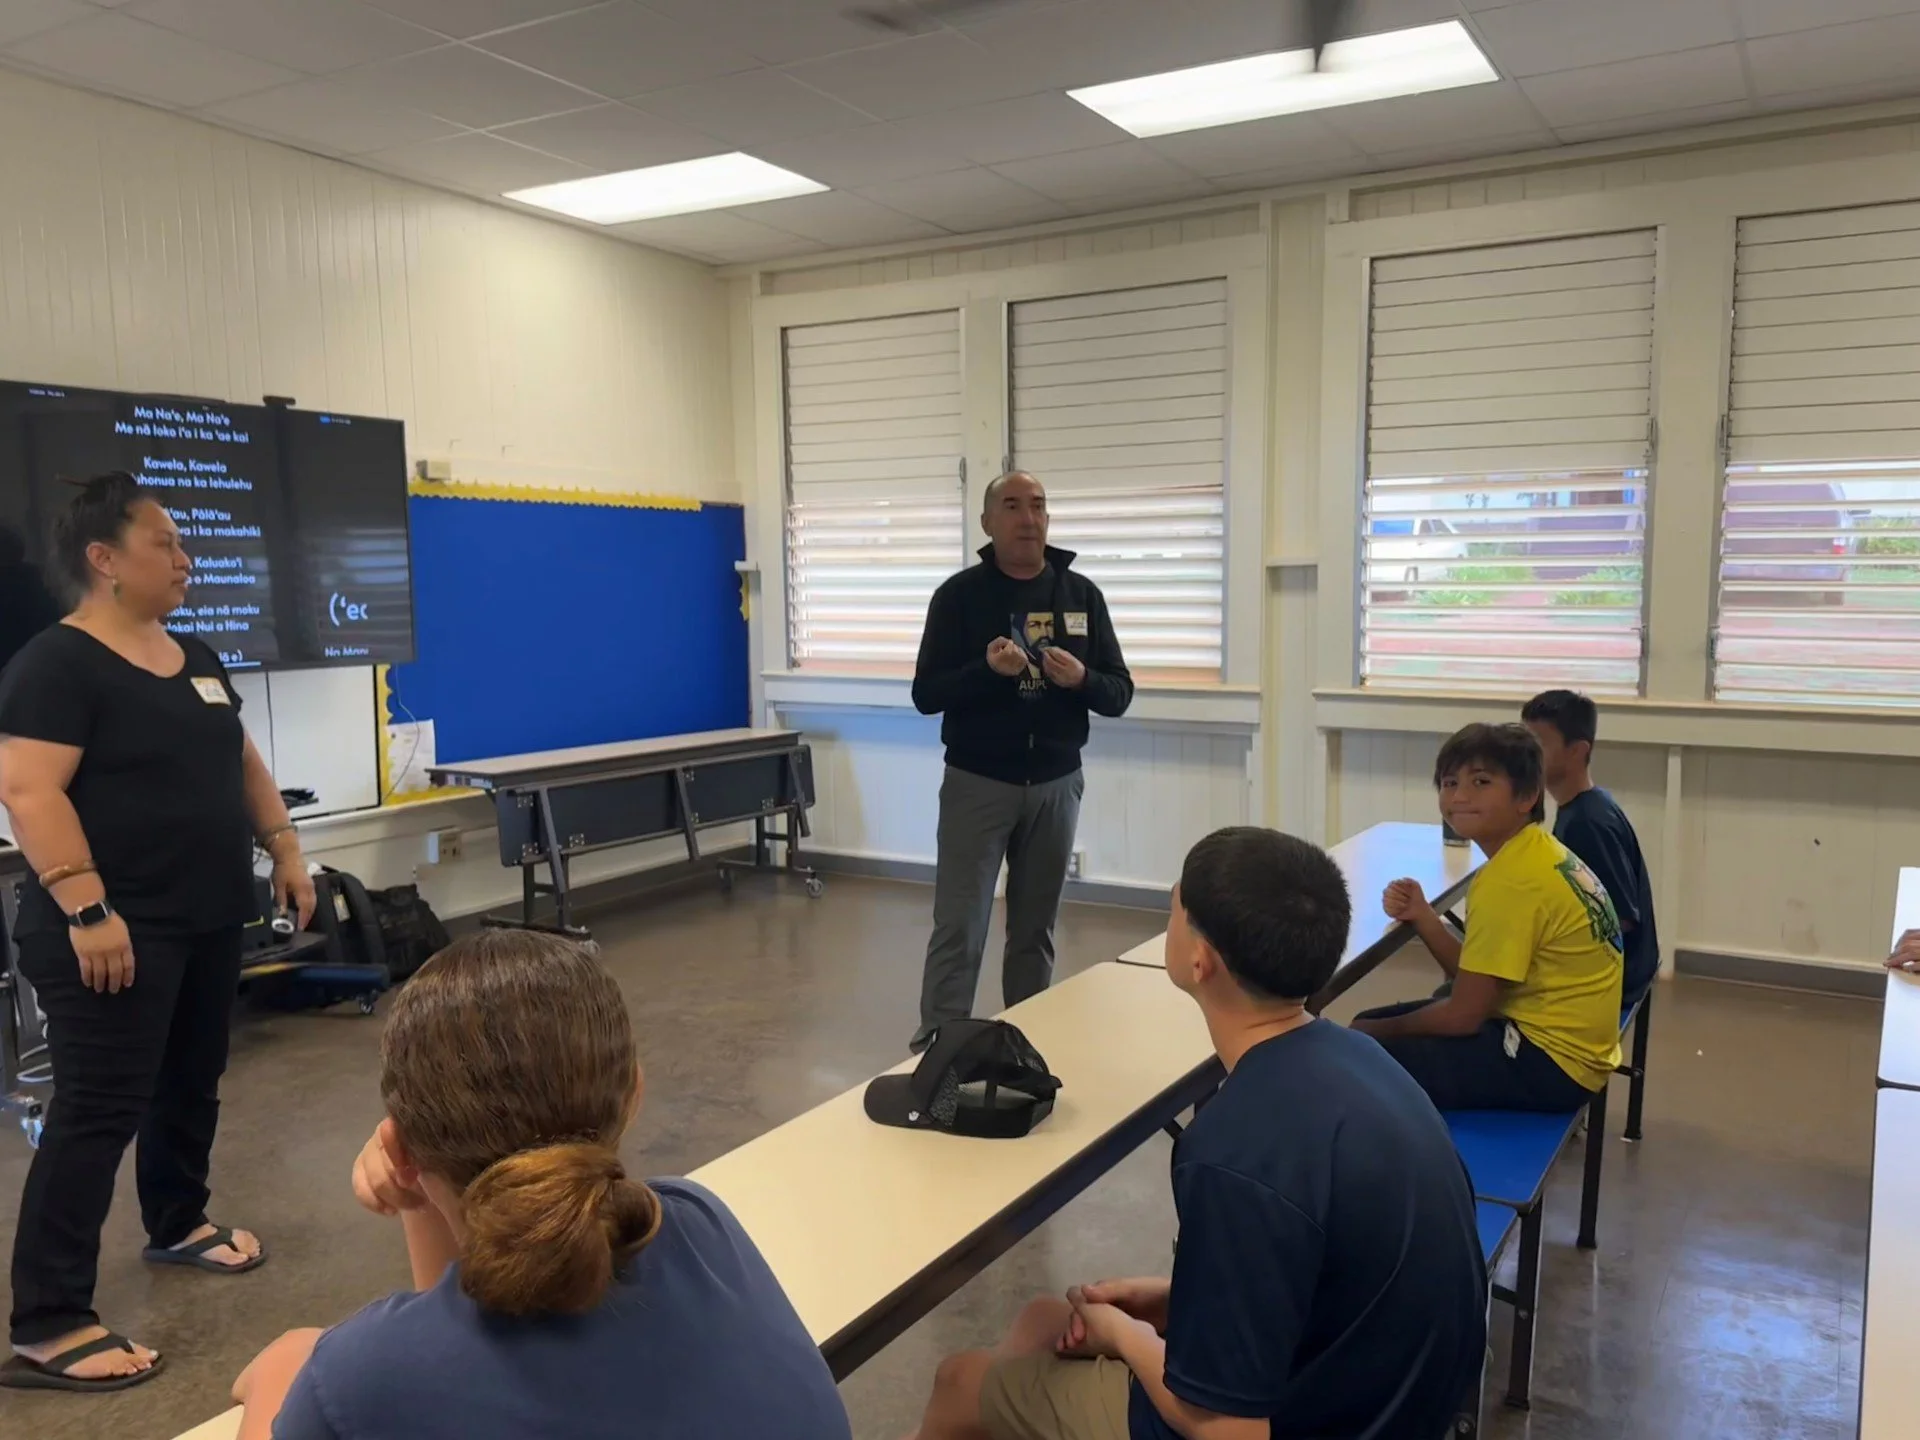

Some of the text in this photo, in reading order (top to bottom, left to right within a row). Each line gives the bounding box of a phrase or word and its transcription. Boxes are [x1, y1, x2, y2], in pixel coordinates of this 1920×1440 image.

[134, 405, 154, 420] Ma
[186, 409, 204, 424] Ma
[114, 420, 134, 435] Me
[152, 423, 177, 438] loko
[199, 428, 214, 441] ka
[232, 430, 249, 444] kai
[143, 456, 227, 473] Kawela, Kawela
[177, 477, 192, 488] na
[194, 475, 208, 488] ka
[209, 477, 252, 491] lehulehu
[198, 526, 212, 537] ka
[214, 527, 261, 538] makahiki
[203, 573, 256, 585] Maunaloa
[197, 606, 215, 617] eia
[231, 603, 260, 616] moku
[196, 620, 214, 632] Nui
[216, 624, 224, 632] a
[225, 619, 250, 632] Hina
